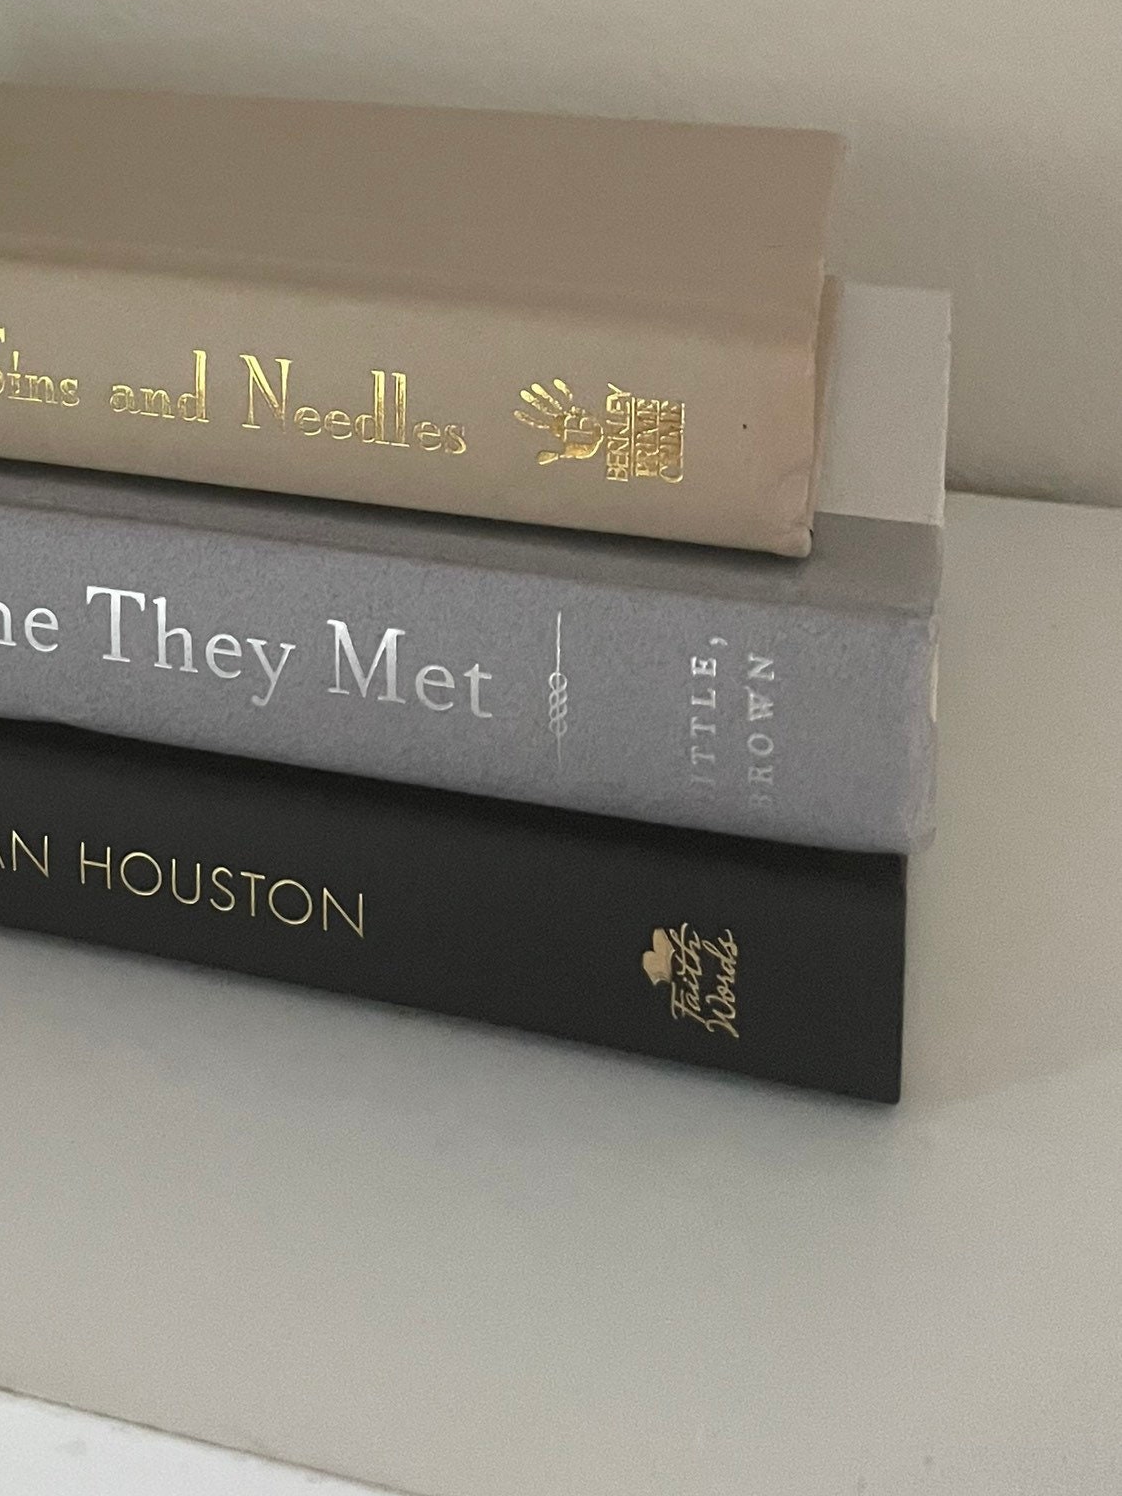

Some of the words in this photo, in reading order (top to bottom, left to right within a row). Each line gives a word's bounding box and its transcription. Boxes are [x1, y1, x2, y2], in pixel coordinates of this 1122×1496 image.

[109, 350, 210, 425] and
[239, 354, 468, 455] Needles
[86, 585, 296, 706] They
[326, 618, 494, 719] Met
[690, 636, 728, 788] ITTLE,
[80, 841, 365, 939] HOUSTON
[670, 922, 706, 1021] Faith
[702, 928, 740, 1038] Words
